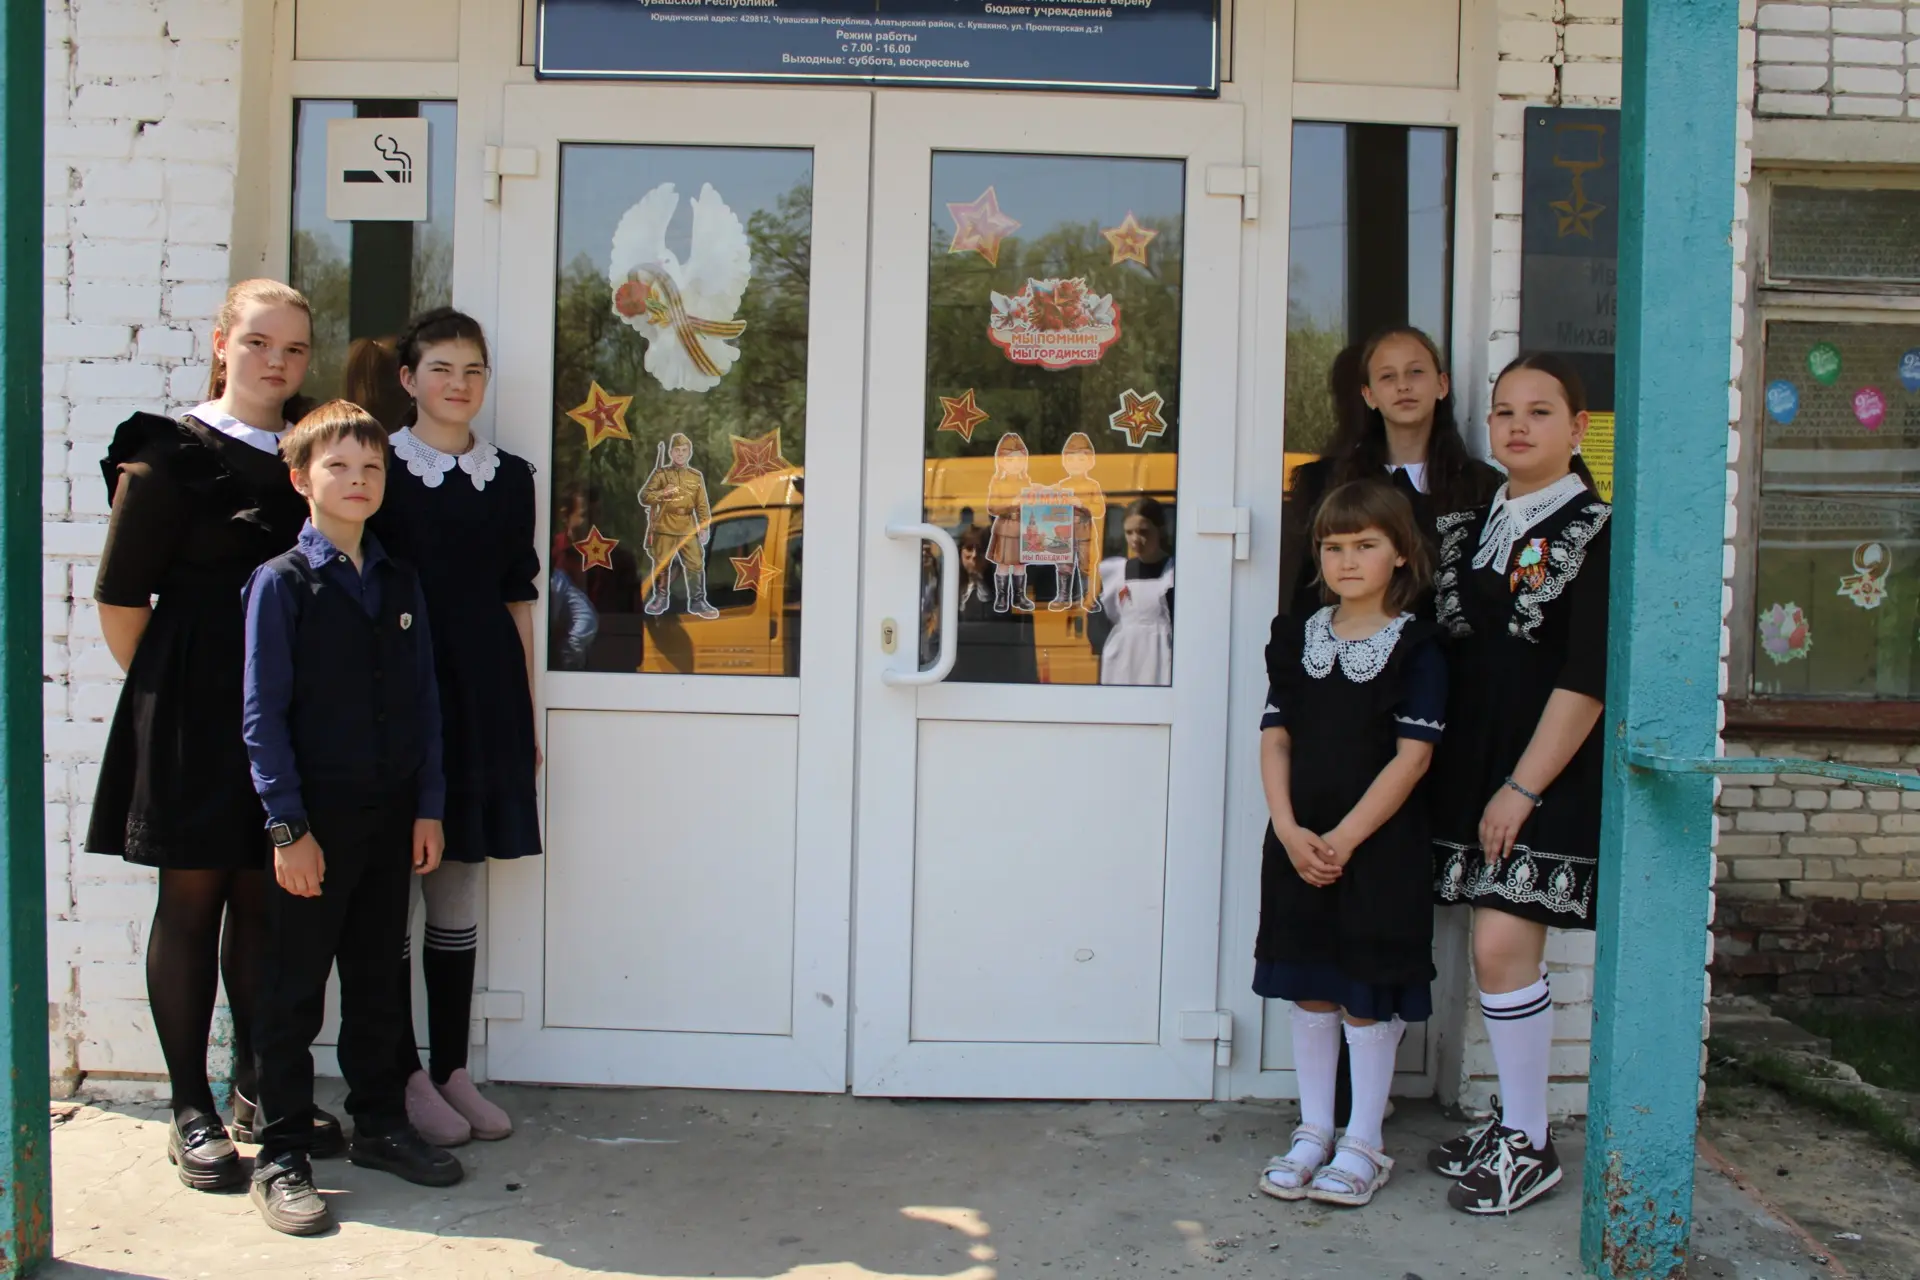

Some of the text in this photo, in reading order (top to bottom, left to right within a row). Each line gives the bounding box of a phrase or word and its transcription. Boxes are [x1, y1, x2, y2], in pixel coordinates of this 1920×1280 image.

[985, 3, 1031, 15] бюджет
[651, 13, 709, 23] Юридический
[711, 15, 738, 24] адрес:
[773, 16, 819, 25] Чувашская
[821, 17, 872, 26] Республика,
[928, 20, 956, 29] район,
[967, 20, 1009, 31] Кувакино,
[1011, 23, 1024, 32] ул.
[1086, 25, 1103, 33] д.21
[836, 30, 917, 42] Режим работы
[851, 43, 873, 53] 7.00
[883, 44, 911, 54] 16.00
[782, 53, 970, 69] Выходные: суббота, воскресенье
[1011, 333, 1098, 345] МЫ ПОМНИМ!
[1012, 349, 1097, 360] МЫ ГОРДИМСЯ!
